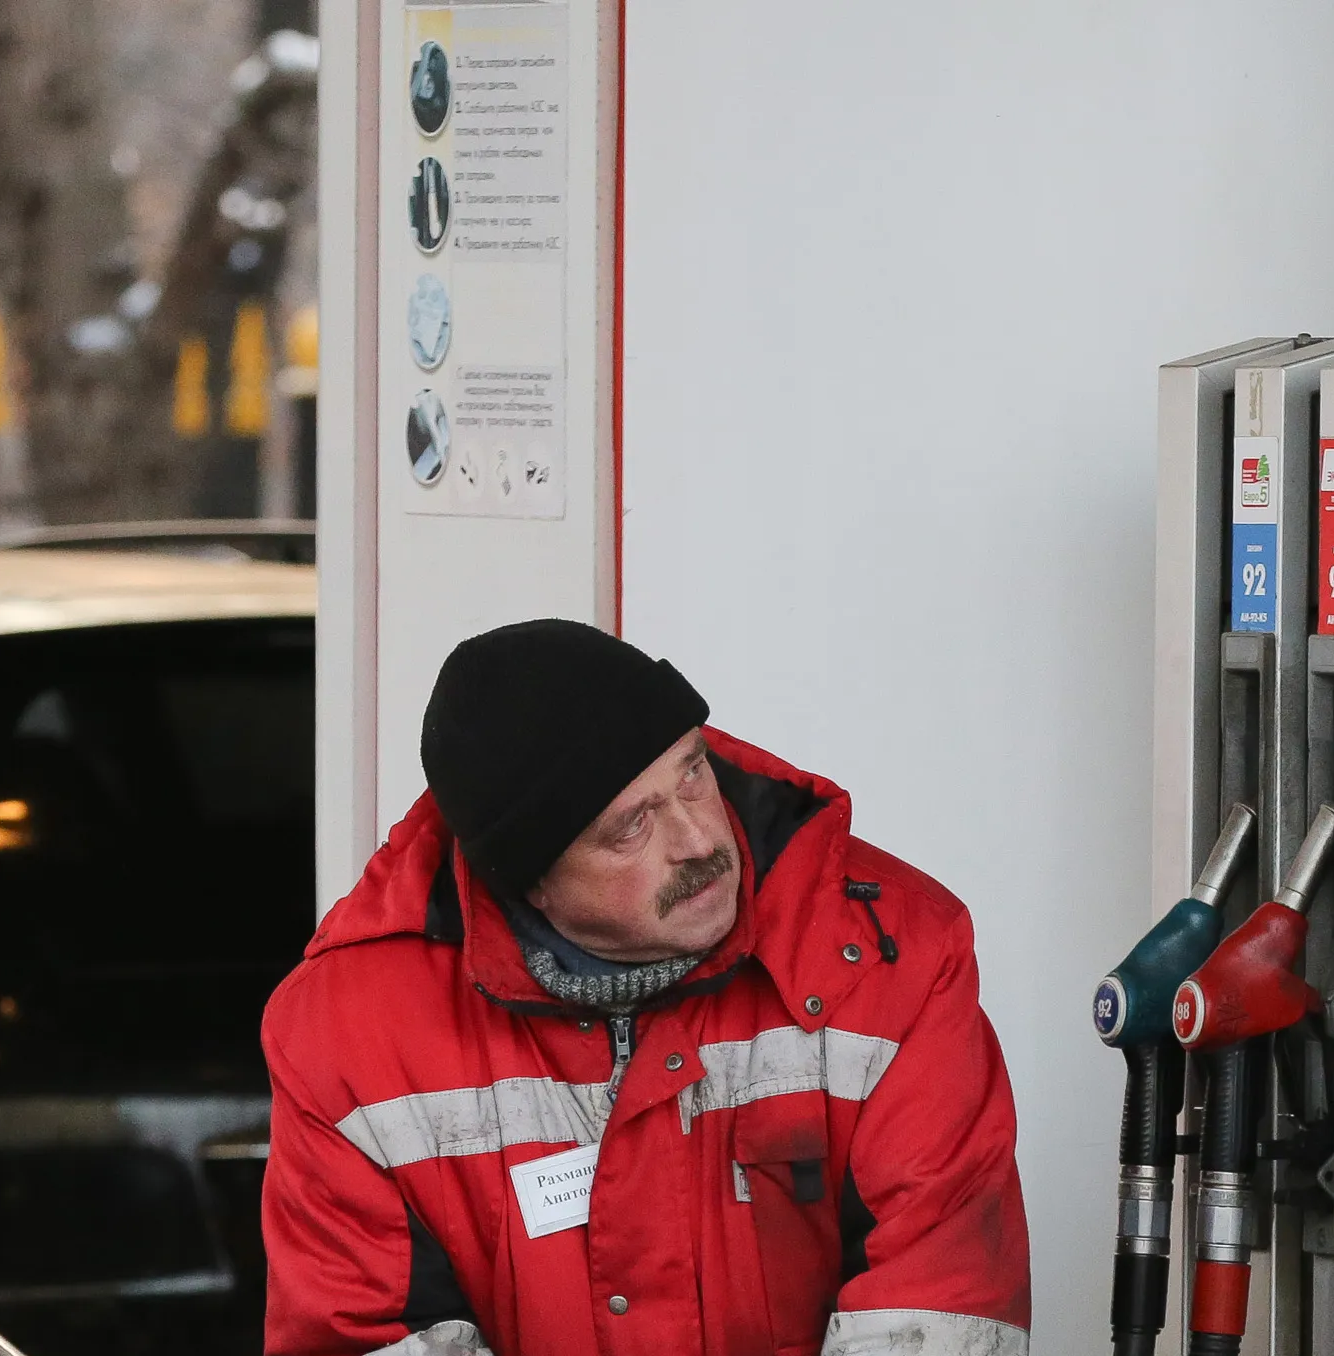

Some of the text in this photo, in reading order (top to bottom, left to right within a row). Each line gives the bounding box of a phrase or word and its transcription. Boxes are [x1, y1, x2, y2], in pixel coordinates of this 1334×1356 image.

[1259, 487, 1267, 503] 5
[1242, 563, 1266, 596] 92
[1098, 999, 1112, 1018] 92
[1177, 1002, 1190, 1020] 98
[542, 1186, 591, 1208] Анато
